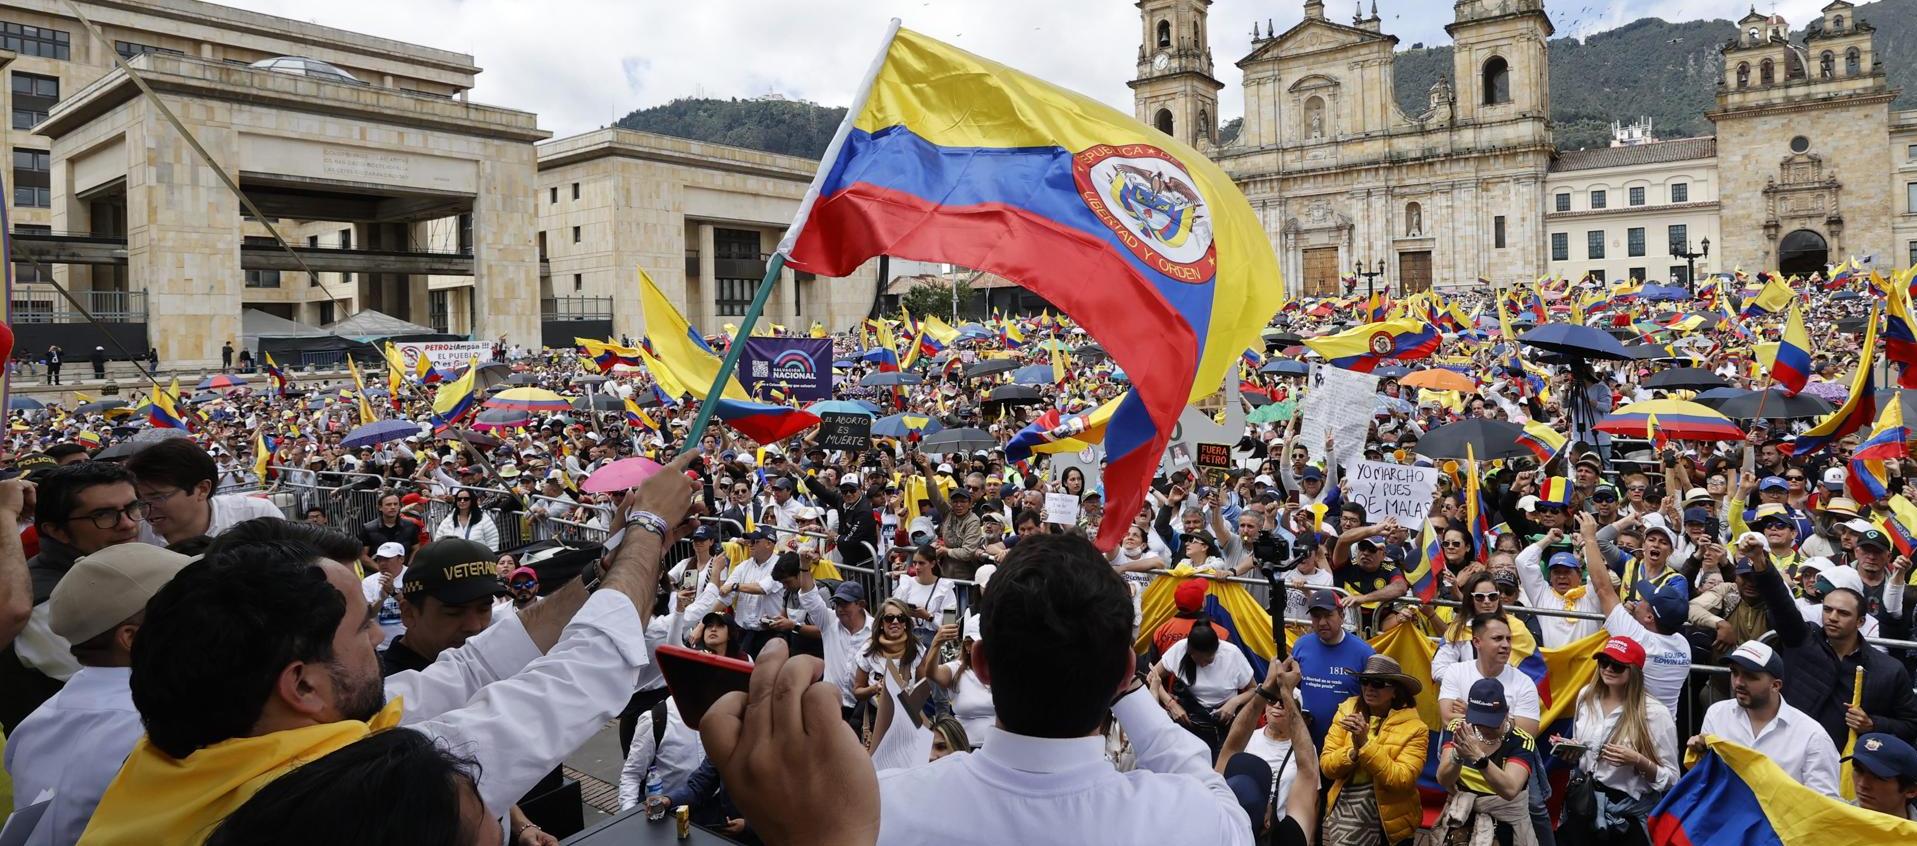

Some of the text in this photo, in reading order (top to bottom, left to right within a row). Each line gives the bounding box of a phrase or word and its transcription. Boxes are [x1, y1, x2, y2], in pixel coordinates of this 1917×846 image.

[1084, 191, 1201, 280] LIBERTAD Y ORDEN
[835, 415, 869, 426] ABORTO
[837, 426, 850, 434] ES
[825, 434, 866, 446] MUERTE
[1201, 445, 1228, 455] FUERA
[1200, 454, 1227, 465] PETRO
[1357, 463, 1425, 483] YO MARCHO
[1369, 482, 1411, 496] Y PUES
[443, 561, 498, 580] VETERAN
[1654, 656, 1677, 665] EDWIN
